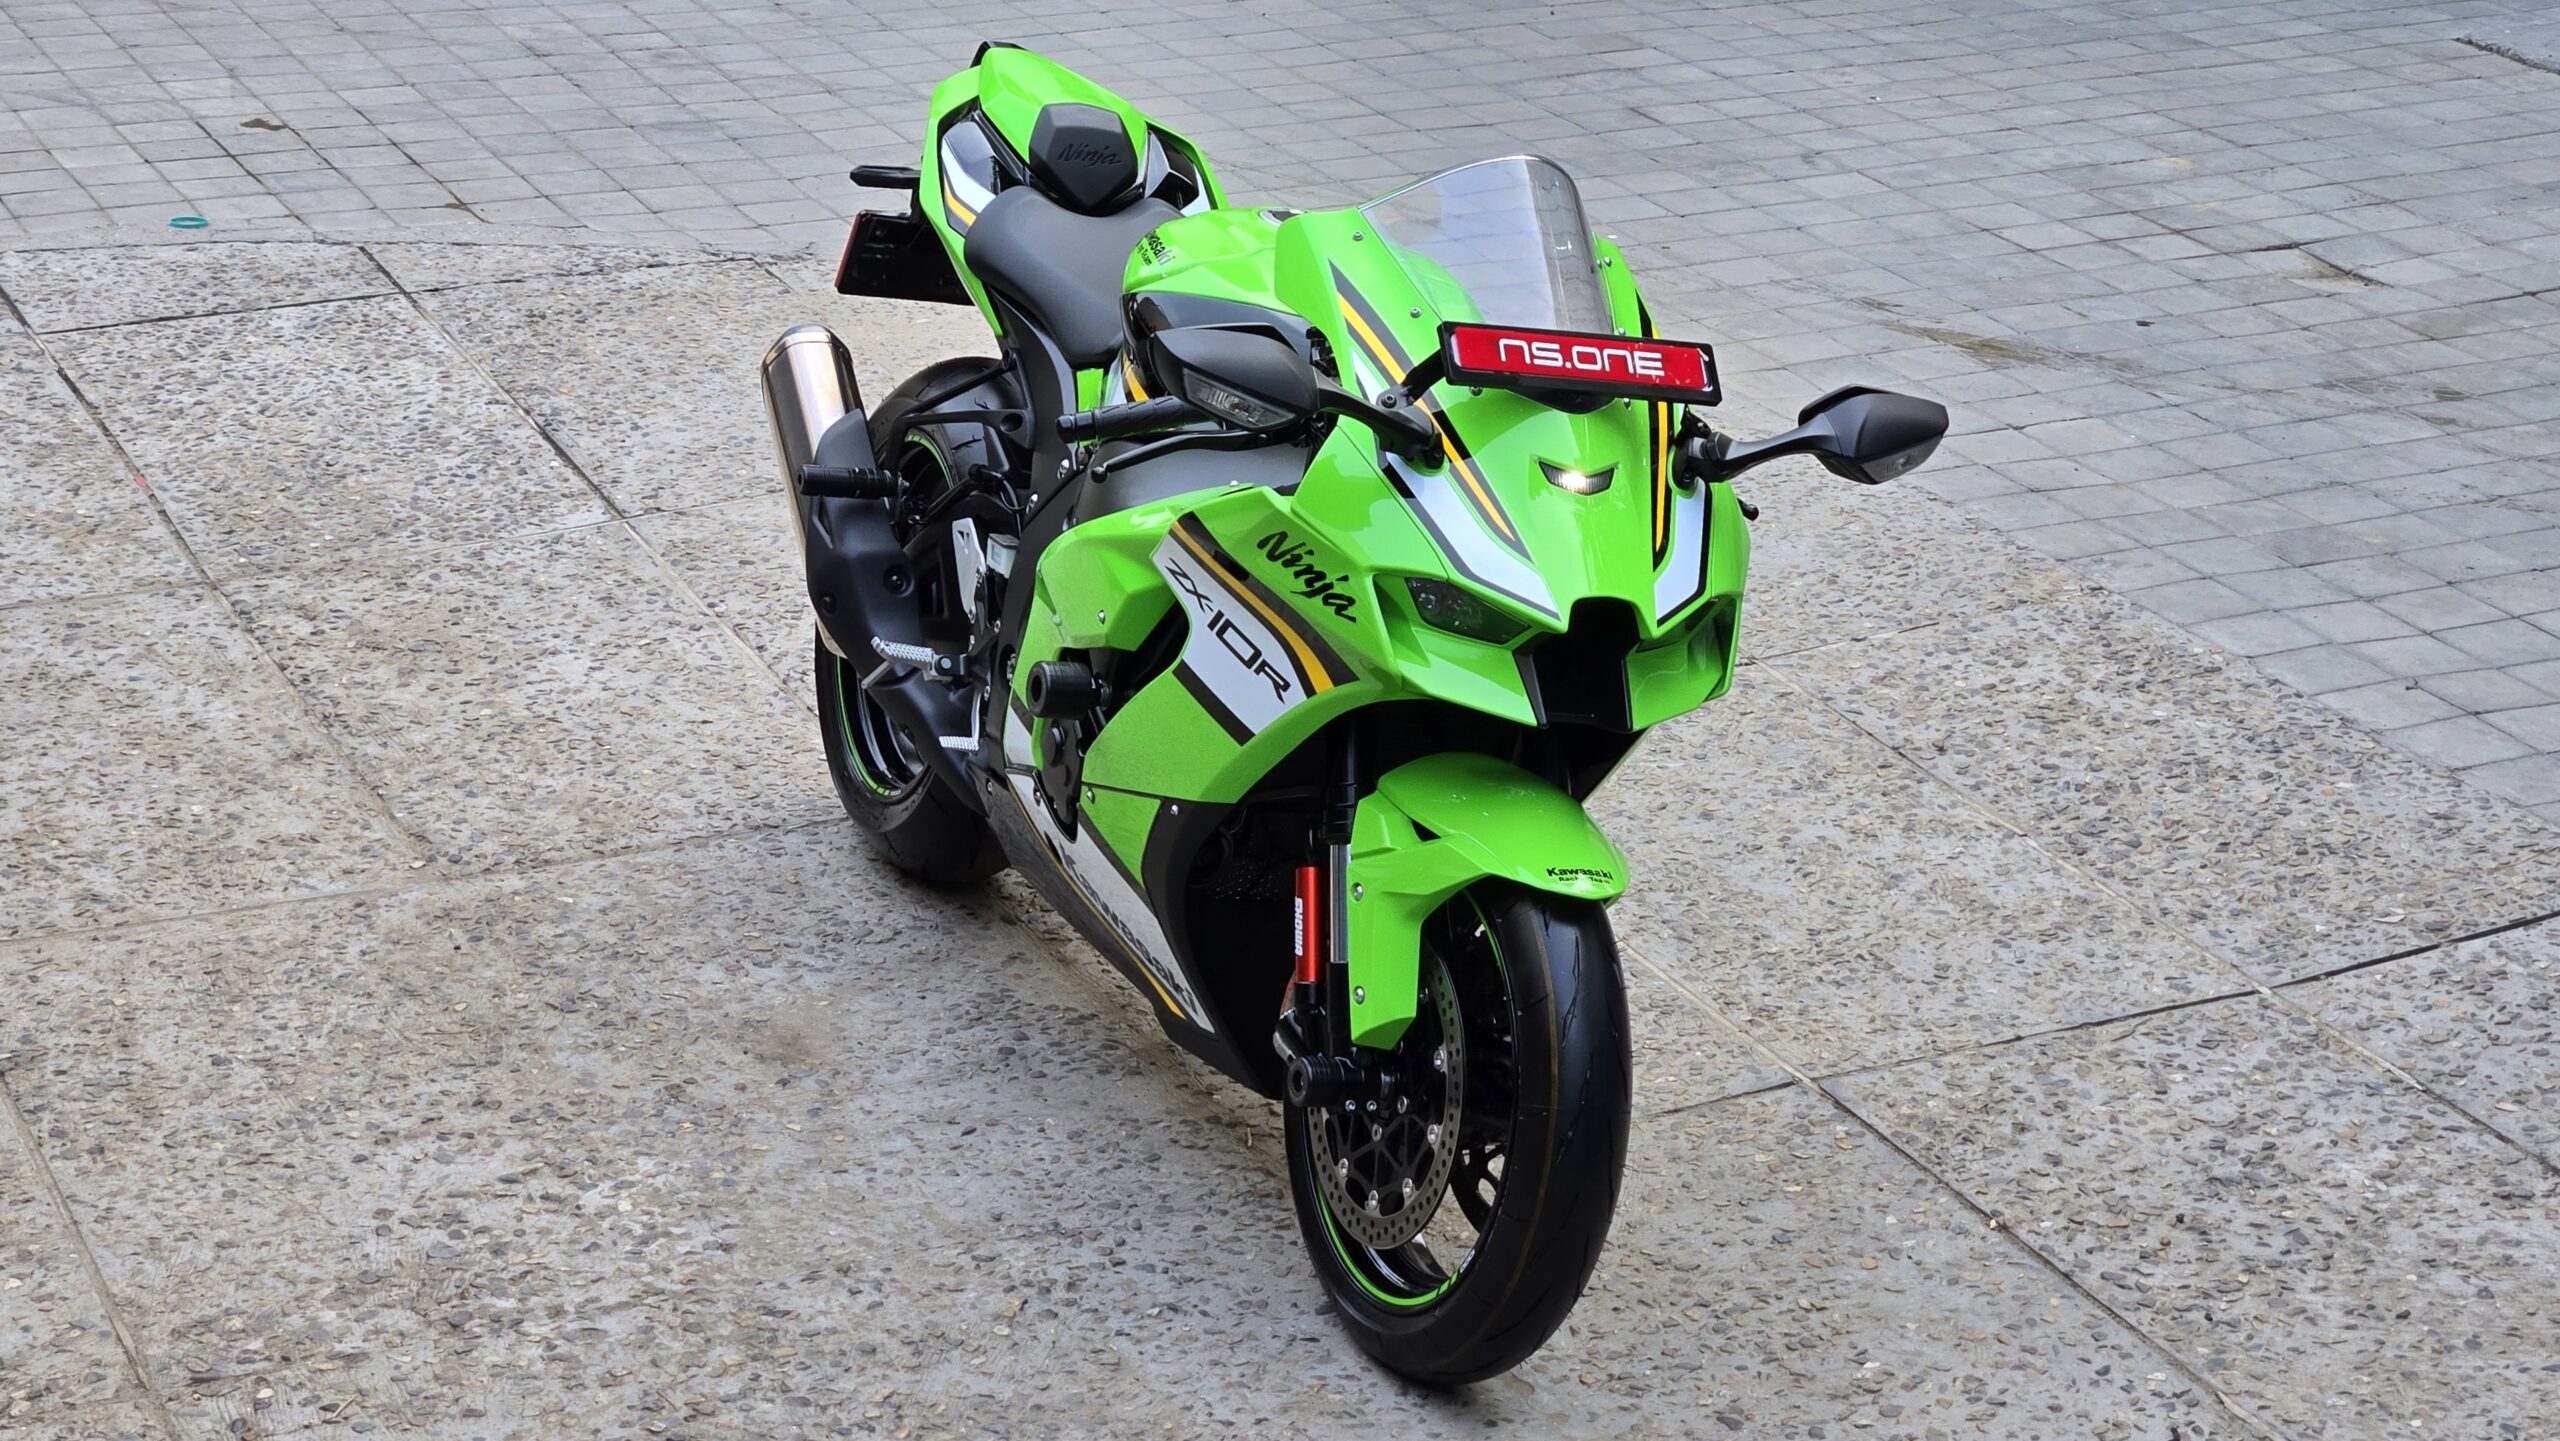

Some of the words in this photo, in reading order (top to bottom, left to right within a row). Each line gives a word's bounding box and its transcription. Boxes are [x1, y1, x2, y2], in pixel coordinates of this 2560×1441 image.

[1058, 143, 1121, 168] Ninja
[1144, 226, 1176, 266] awasaki
[1256, 530, 1357, 624] Ninja
[1164, 556, 1291, 705] ZX-10R
[1546, 867, 1614, 881] Kawasaki
[1058, 841, 1199, 1017] Kawasaki
[1294, 896, 1303, 956] SHOWA
